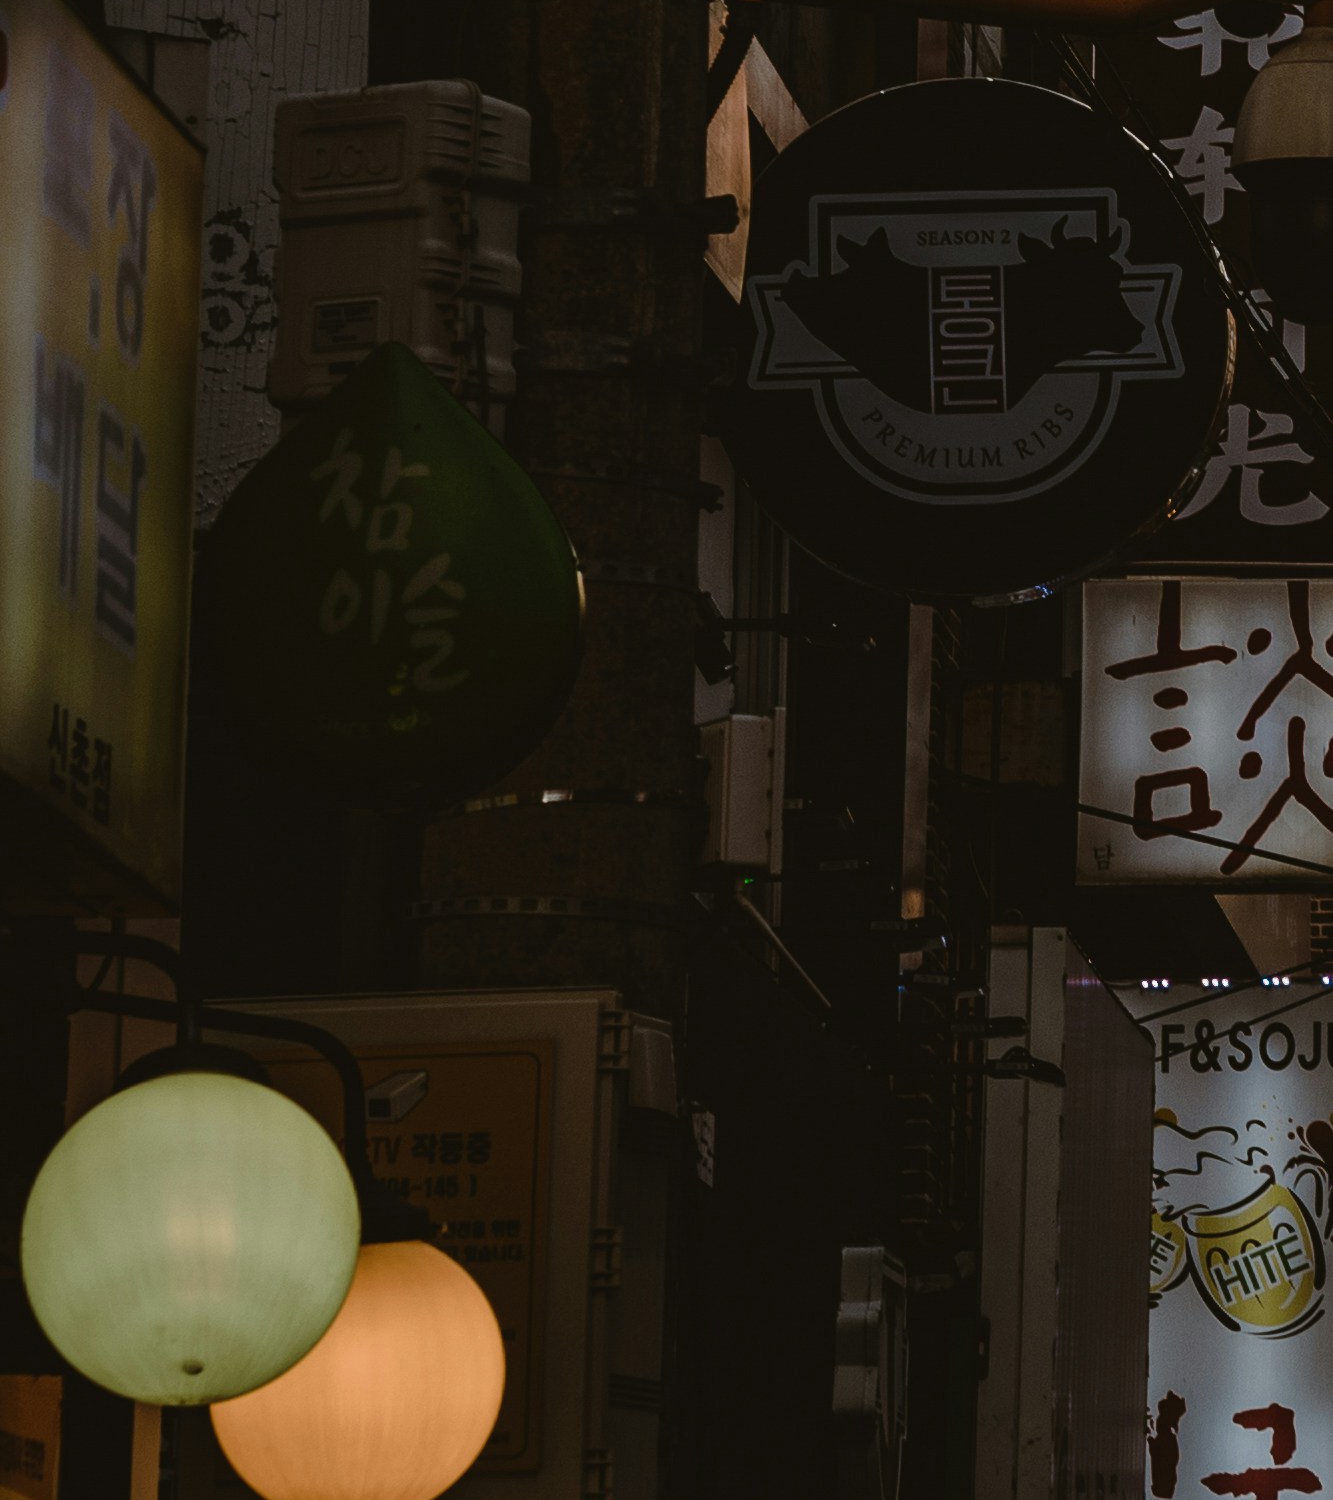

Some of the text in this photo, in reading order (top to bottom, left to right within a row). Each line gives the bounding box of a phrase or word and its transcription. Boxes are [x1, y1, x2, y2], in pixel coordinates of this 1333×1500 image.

[915, 228, 1012, 247] SEASON 2
[860, 401, 1076, 470] PREMIUM RIBS
[47, 700, 114, 832] 신촌점
[1212, 1233, 1311, 1304] HITE
